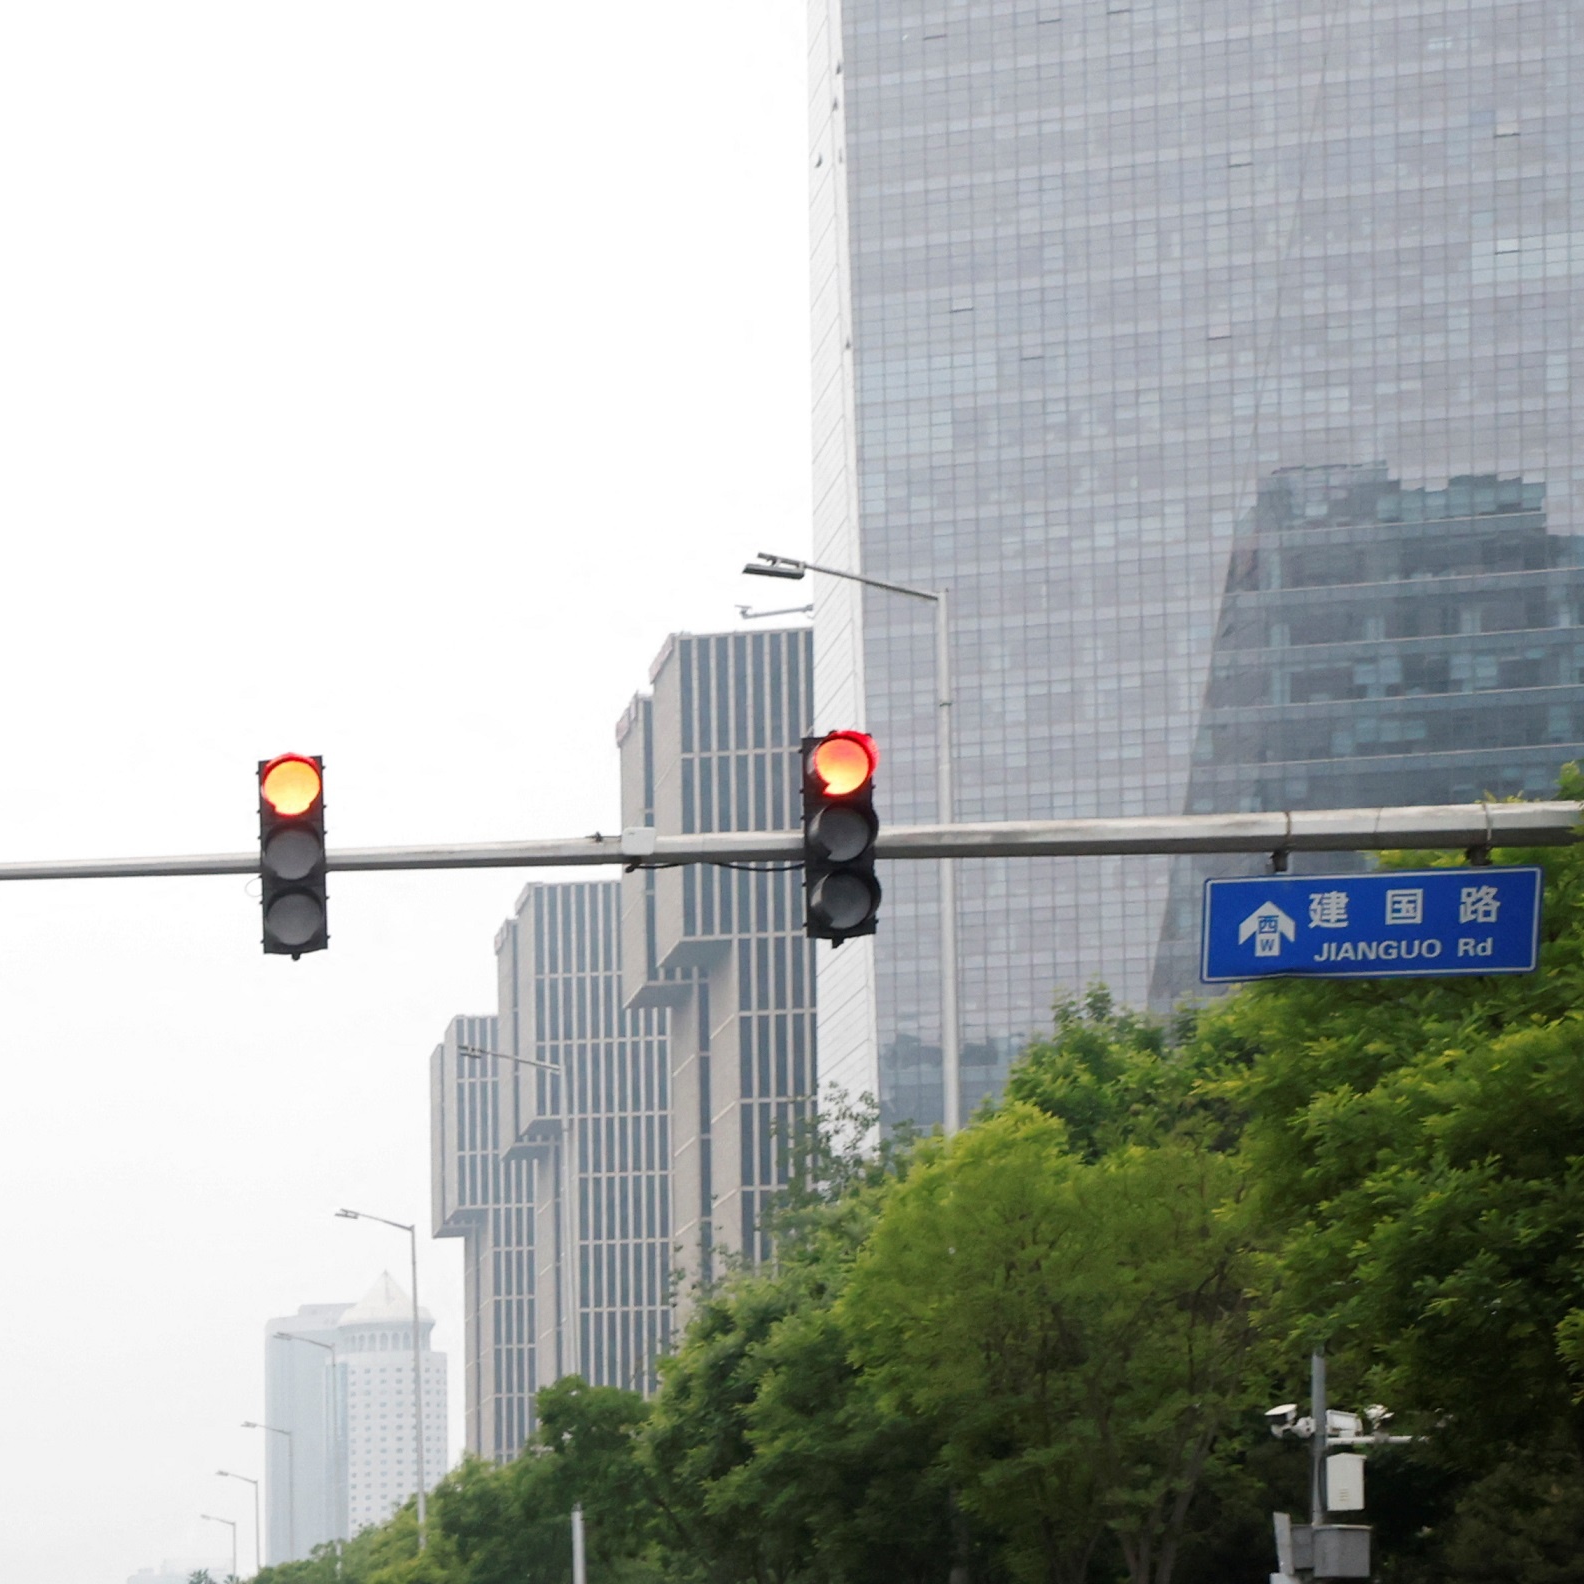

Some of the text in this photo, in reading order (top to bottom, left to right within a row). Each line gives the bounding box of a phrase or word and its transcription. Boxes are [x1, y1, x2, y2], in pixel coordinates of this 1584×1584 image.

[1308, 885, 1501, 929] 建国路
[1257, 914, 1280, 934] 西
[1261, 939, 1275, 952] W
[1313, 937, 1493, 962] JIANGUO Rd
